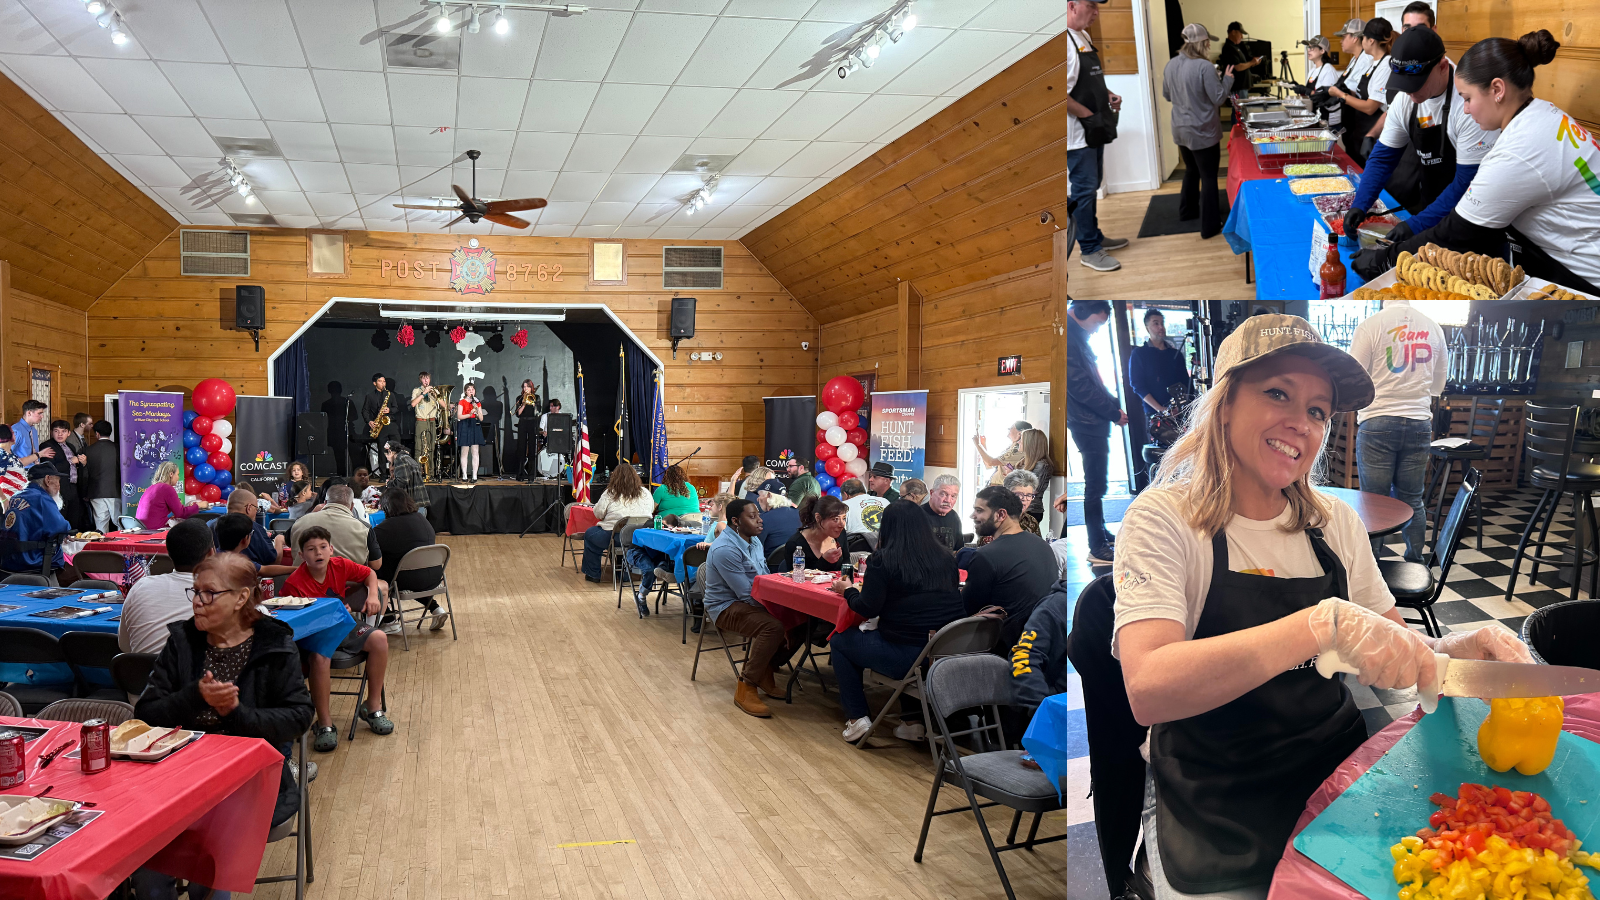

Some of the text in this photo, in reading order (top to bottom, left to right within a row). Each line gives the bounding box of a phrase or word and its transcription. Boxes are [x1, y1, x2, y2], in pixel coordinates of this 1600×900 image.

[381, 259, 564, 282] POST 8762
[1387, 324, 1430, 343] Team
[1001, 358, 1019, 373] EXIT
[1386, 343, 1433, 374] UP
[881, 421, 915, 434] HUNT.
[880, 435, 914, 449] FISH.
[240, 461, 288, 471] COMCAST
